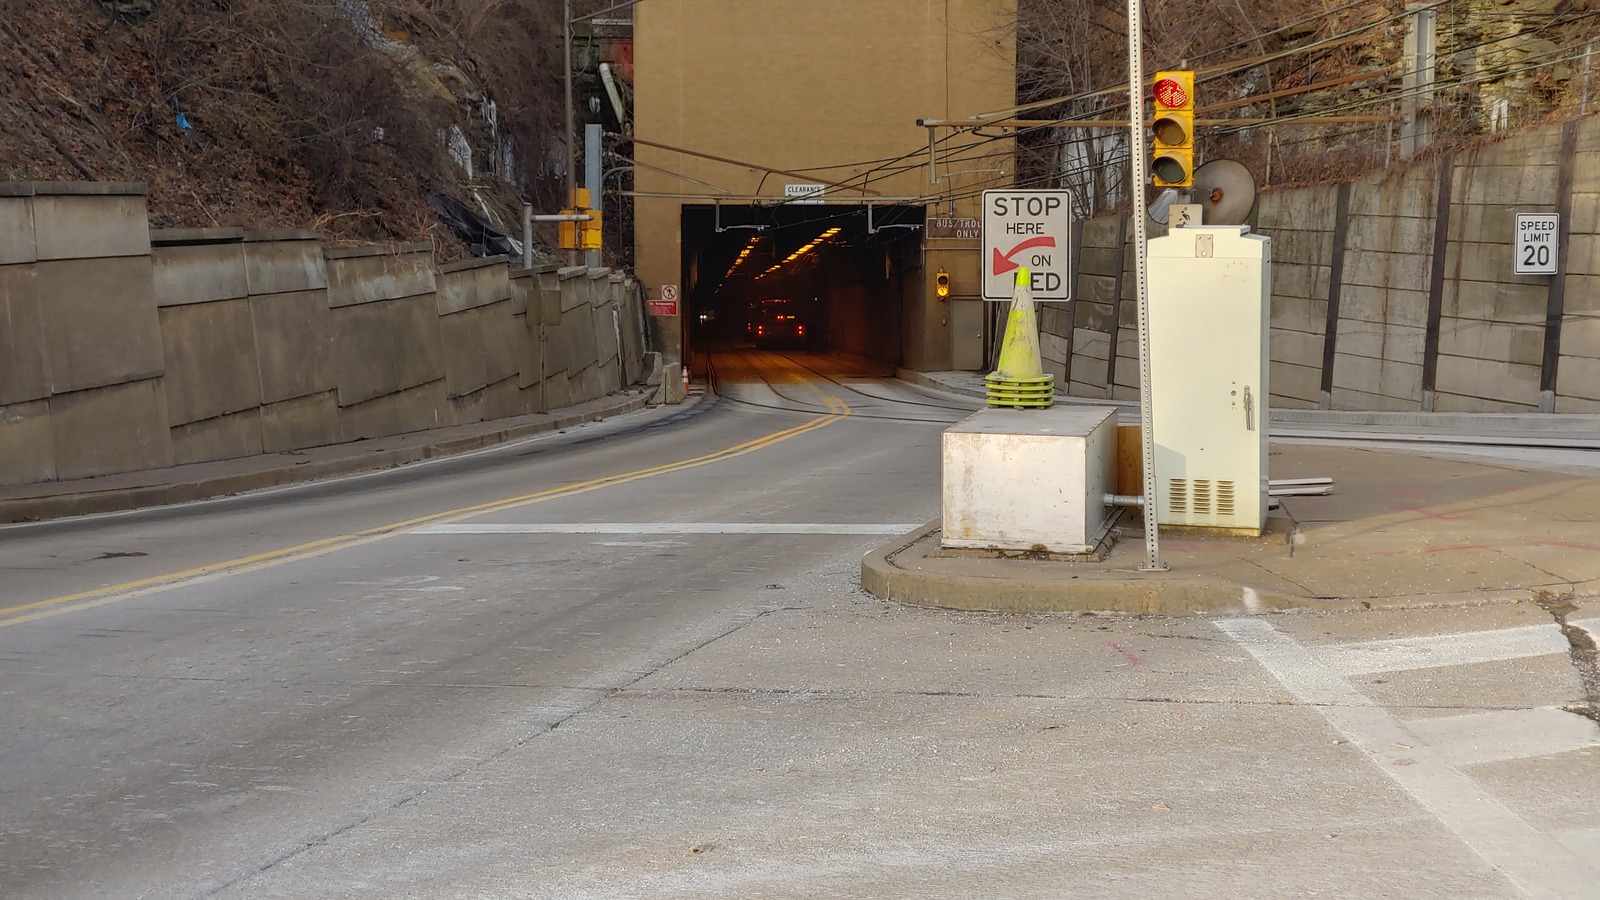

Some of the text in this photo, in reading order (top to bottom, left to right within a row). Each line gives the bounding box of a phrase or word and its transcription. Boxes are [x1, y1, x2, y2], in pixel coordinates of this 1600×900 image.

[993, 197, 1061, 217] STOP
[1006, 222, 1045, 235] HERE
[1520, 221, 1555, 230] SPEED
[956, 229, 979, 238] ONLY
[1523, 233, 1551, 242] LIMIT
[1031, 254, 1052, 267] ON
[1523, 244, 1550, 266] 20
